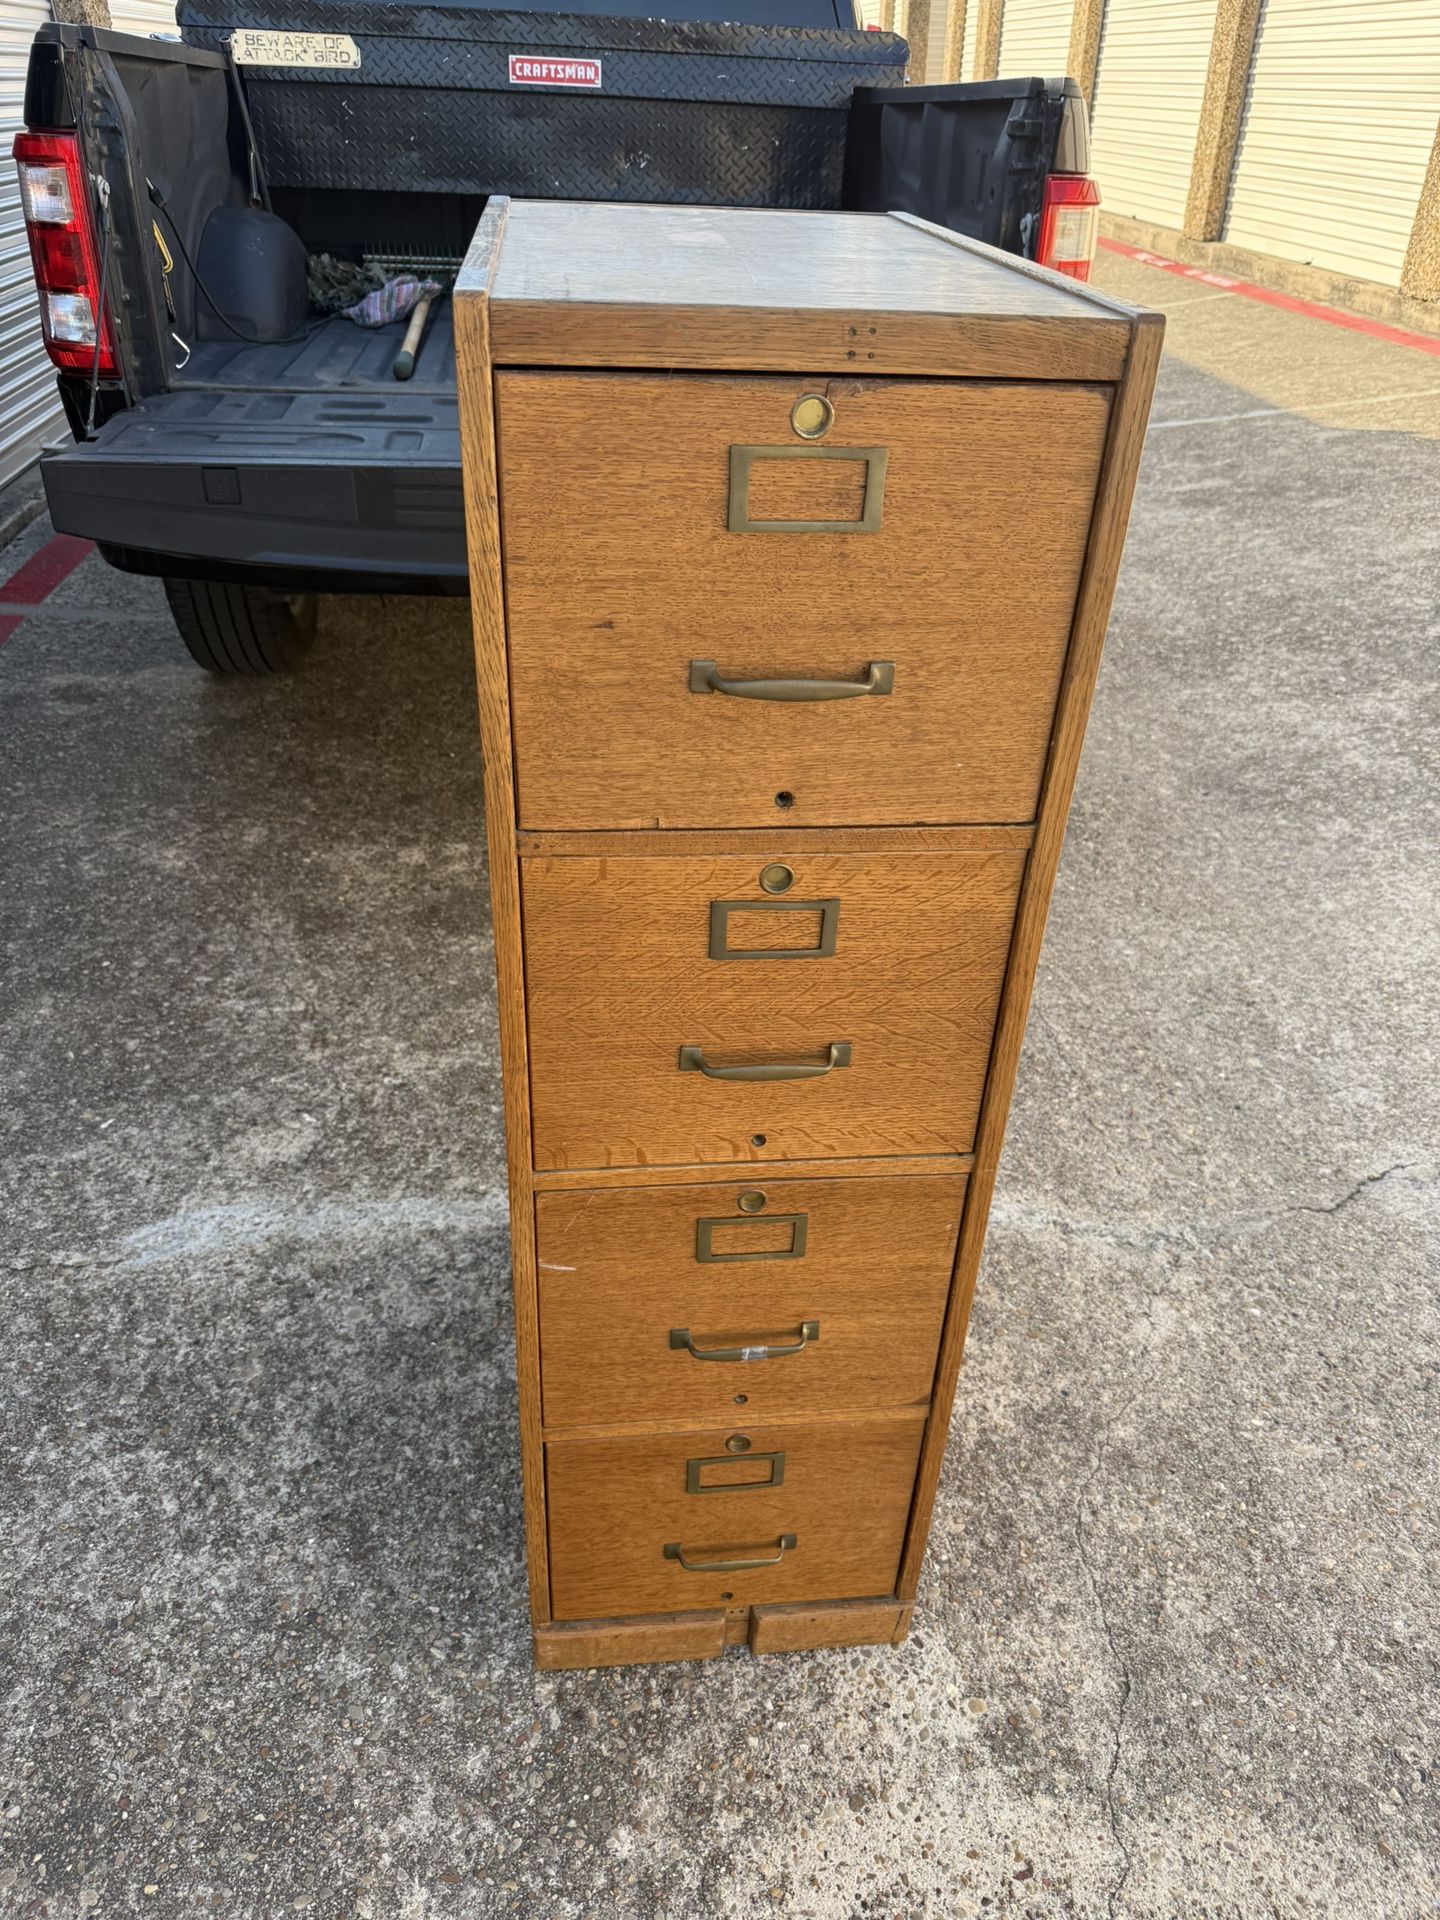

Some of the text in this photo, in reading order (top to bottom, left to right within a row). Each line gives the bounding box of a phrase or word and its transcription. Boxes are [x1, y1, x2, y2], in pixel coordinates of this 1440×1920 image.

[244, 34, 345, 49] BEWARE OF
[243, 47, 351, 63] ATTACK BIRD
[515, 62, 595, 80] CRAFTSMAN
